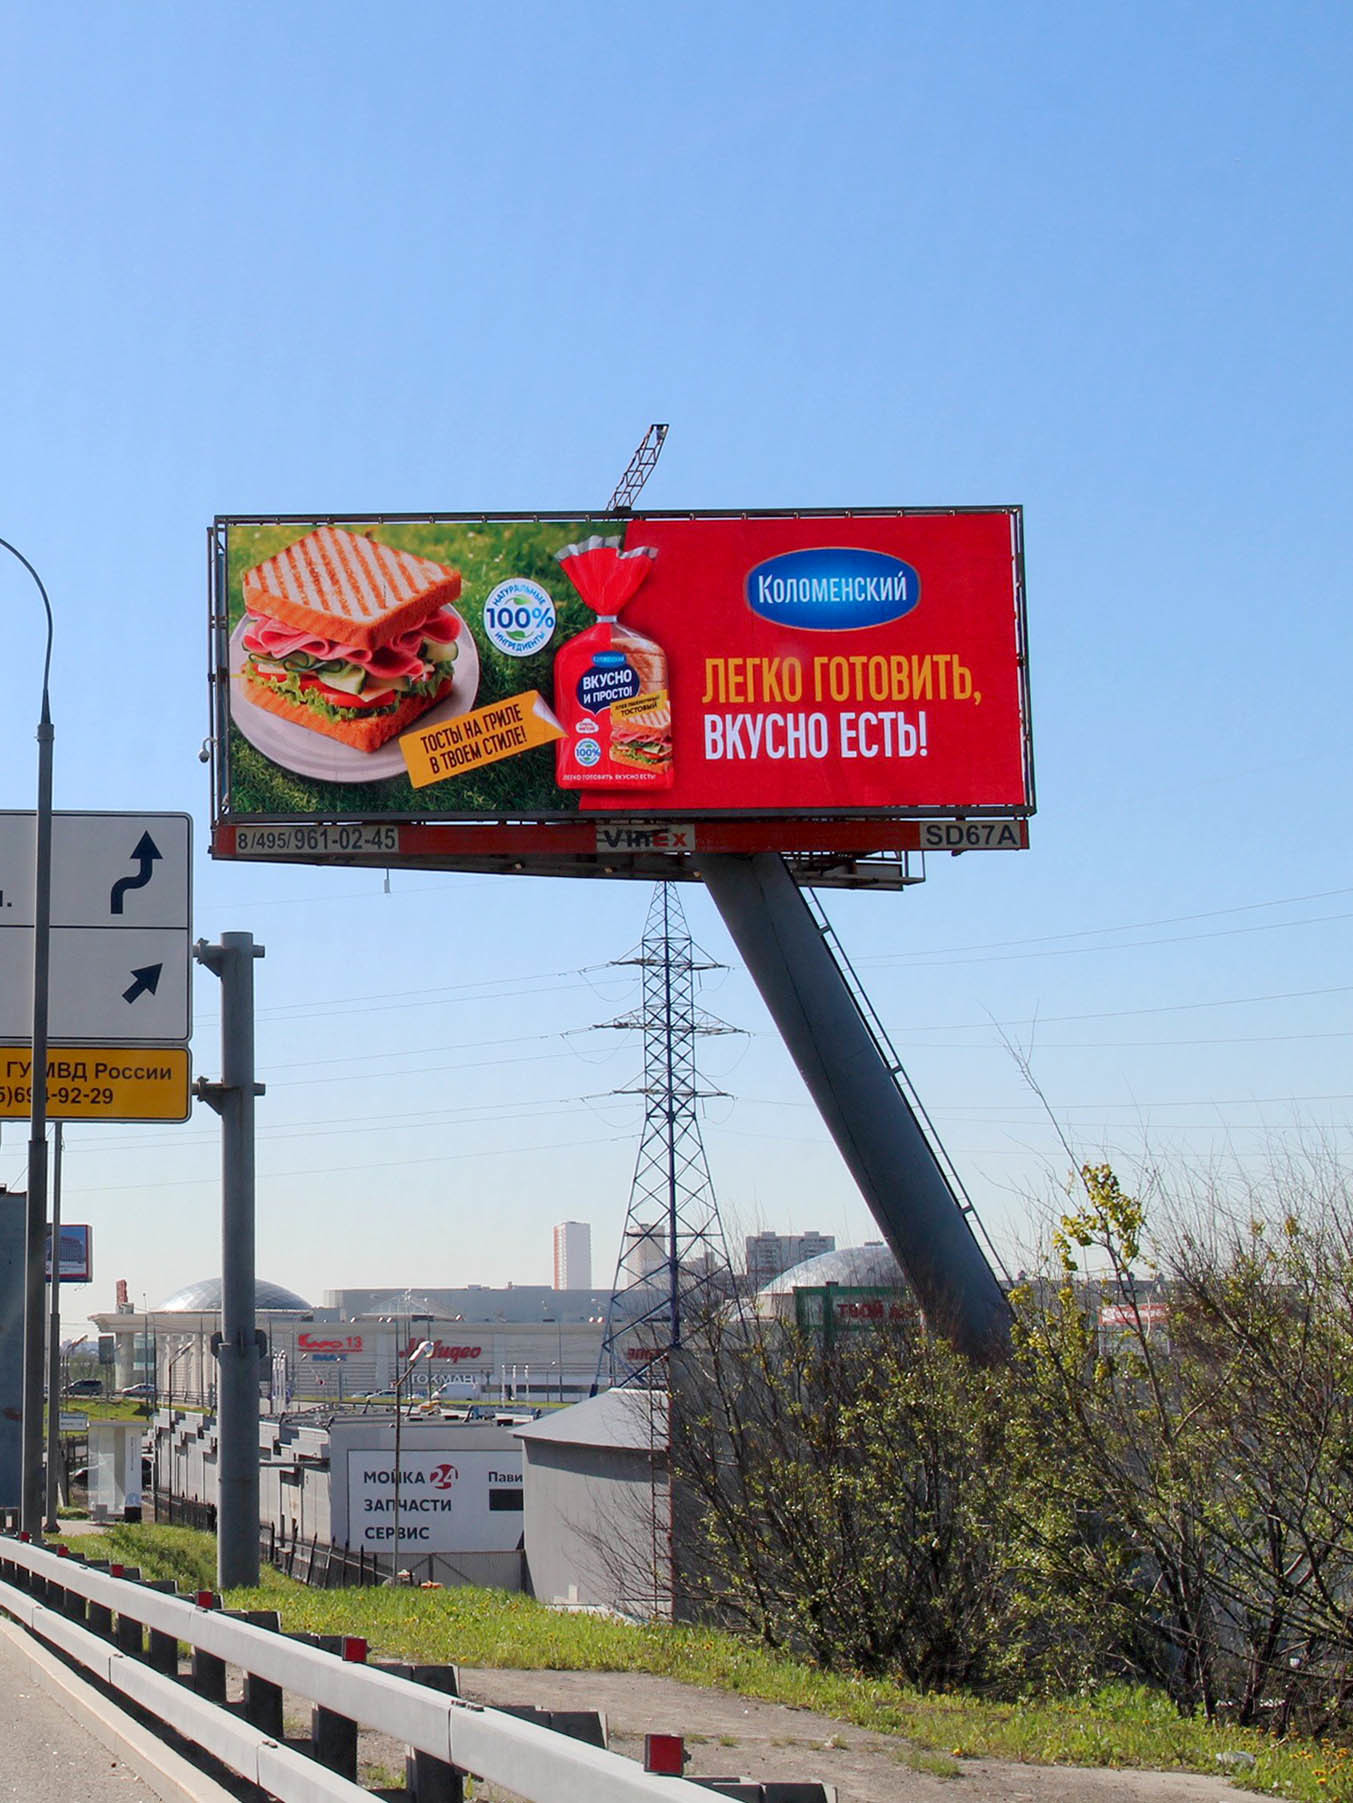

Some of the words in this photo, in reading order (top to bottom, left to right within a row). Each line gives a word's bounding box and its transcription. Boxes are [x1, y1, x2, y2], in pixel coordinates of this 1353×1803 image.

[486, 607, 555, 629] 100%
[582, 669, 633, 690] ВКУСНО
[702, 656, 803, 704] ЛЕГКО
[813, 654, 982, 705] ГОТОВИТЬ,
[583, 693, 591, 704] И
[593, 686, 633, 702] ПРОСТО!
[420, 724, 463, 754] ТОСТЫ
[463, 719, 483, 740] НА
[482, 703, 523, 732] ГРИЛЕ
[704, 711, 829, 760] ВКУСНО
[840, 710, 928, 758] ЕСТЬ!
[429, 756, 441, 775] В
[440, 741, 482, 771] ТВОЕМ
[482, 725, 528, 755] СТИЛЕ!
[925, 824, 1017, 846] SD67A
[6, 1061, 32, 1078] ГУ
[95, 1062, 172, 1080] России
[345, 1336, 362, 1348] 13
[364, 1469, 425, 1484] МОЙКА
[431, 1465, 458, 1489] 24
[364, 1499, 452, 1512] ЗАПЧАСТИ
[365, 1527, 430, 1540] СЕРВИС
